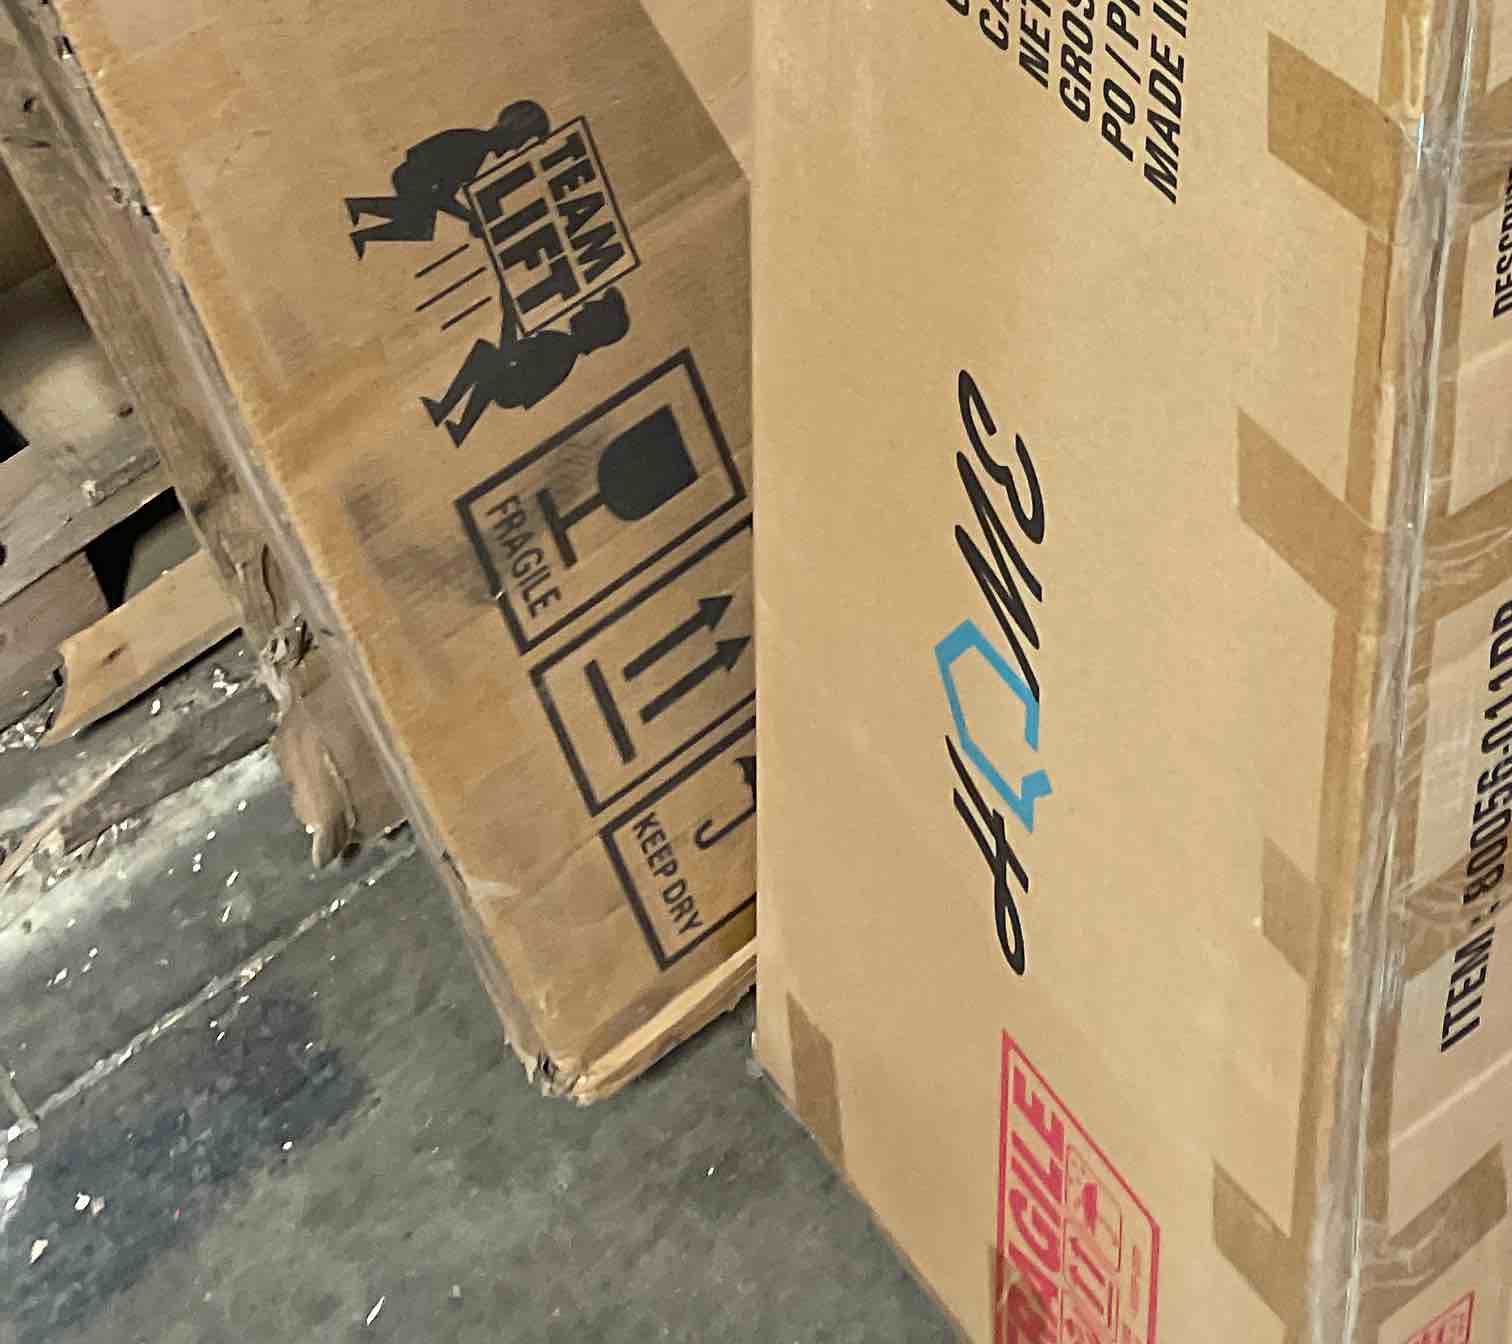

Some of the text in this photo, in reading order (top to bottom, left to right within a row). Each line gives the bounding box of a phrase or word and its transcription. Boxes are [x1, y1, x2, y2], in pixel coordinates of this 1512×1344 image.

[1102, 78, 1135, 162] PO
[1144, 34, 1184, 204] MADE
[474, 161, 578, 317] LIFT
[539, 130, 626, 284] TEAM
[486, 493, 562, 619] FRAGILE
[632, 811, 702, 936] KEEP DRY
[1441, 924, 1496, 1053] ITEM
